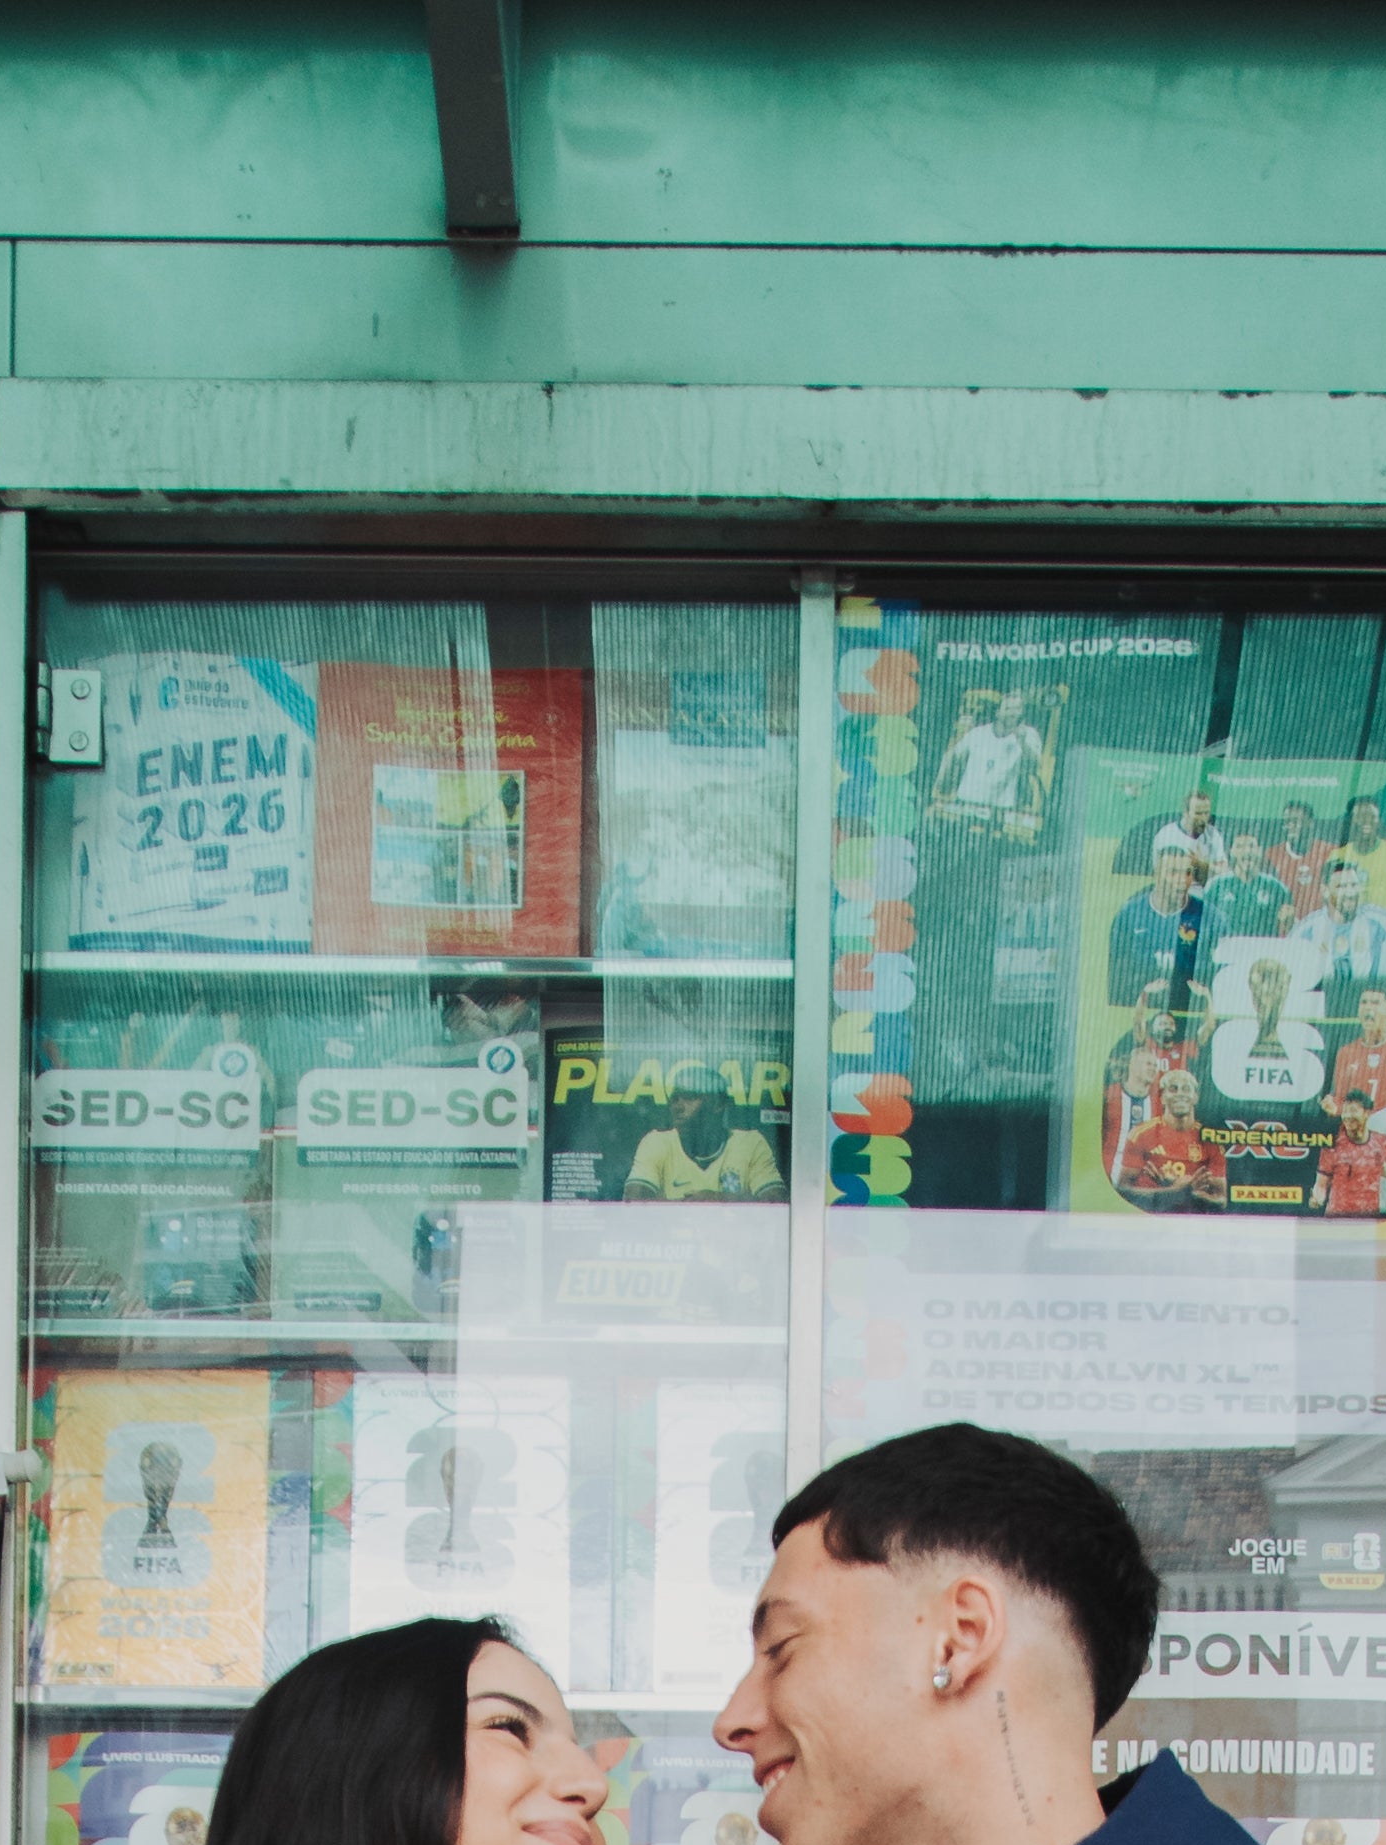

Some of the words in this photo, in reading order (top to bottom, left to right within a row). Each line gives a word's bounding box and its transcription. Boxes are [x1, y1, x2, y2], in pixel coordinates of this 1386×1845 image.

[936, 641, 983, 662] FIFA
[985, 640, 1067, 661] WORLD
[1069, 638, 1114, 657] CUP
[1116, 637, 1194, 657] 2026
[136, 732, 288, 798] ENEM
[136, 787, 286, 852] 2026
[1244, 1067, 1294, 1086] FIFA
[41, 1089, 250, 1130] SED-SC
[308, 1087, 518, 1128] SED-SC
[1201, 1126, 1335, 1148] ADRENALYN
[55, 1183, 139, 1196] ORIENTADOR
[140, 1183, 235, 1197] EDUCACIONAL
[342, 1183, 420, 1195] PROFESSOR
[430, 1183, 482, 1195] DIREITO
[1235, 1188, 1299, 1200] PANINI
[567, 1266, 611, 1298] EU
[615, 1266, 679, 1300] VOU
[962, 1299, 1110, 1322] MAIOR
[1116, 1300, 1301, 1327] EVENTO.
[962, 1328, 1108, 1351] MAIOR
[921, 1387, 967, 1414] DE
[975, 1388, 1136, 1415] TODOS
[1139, 1389, 1209, 1416] OS
[1228, 1537, 1308, 1558] JOGUE
[133, 1556, 183, 1575] FIFA
[1250, 1556, 1286, 1576] EM
[1324, 1574, 1380, 1587] PANINI
[98, 1613, 211, 1639] 2026
[102, 1751, 142, 1763] LIVRO
[144, 1752, 221, 1766] ILUSTRADO
[1173, 1739, 1376, 1776] COMUNIDADE
